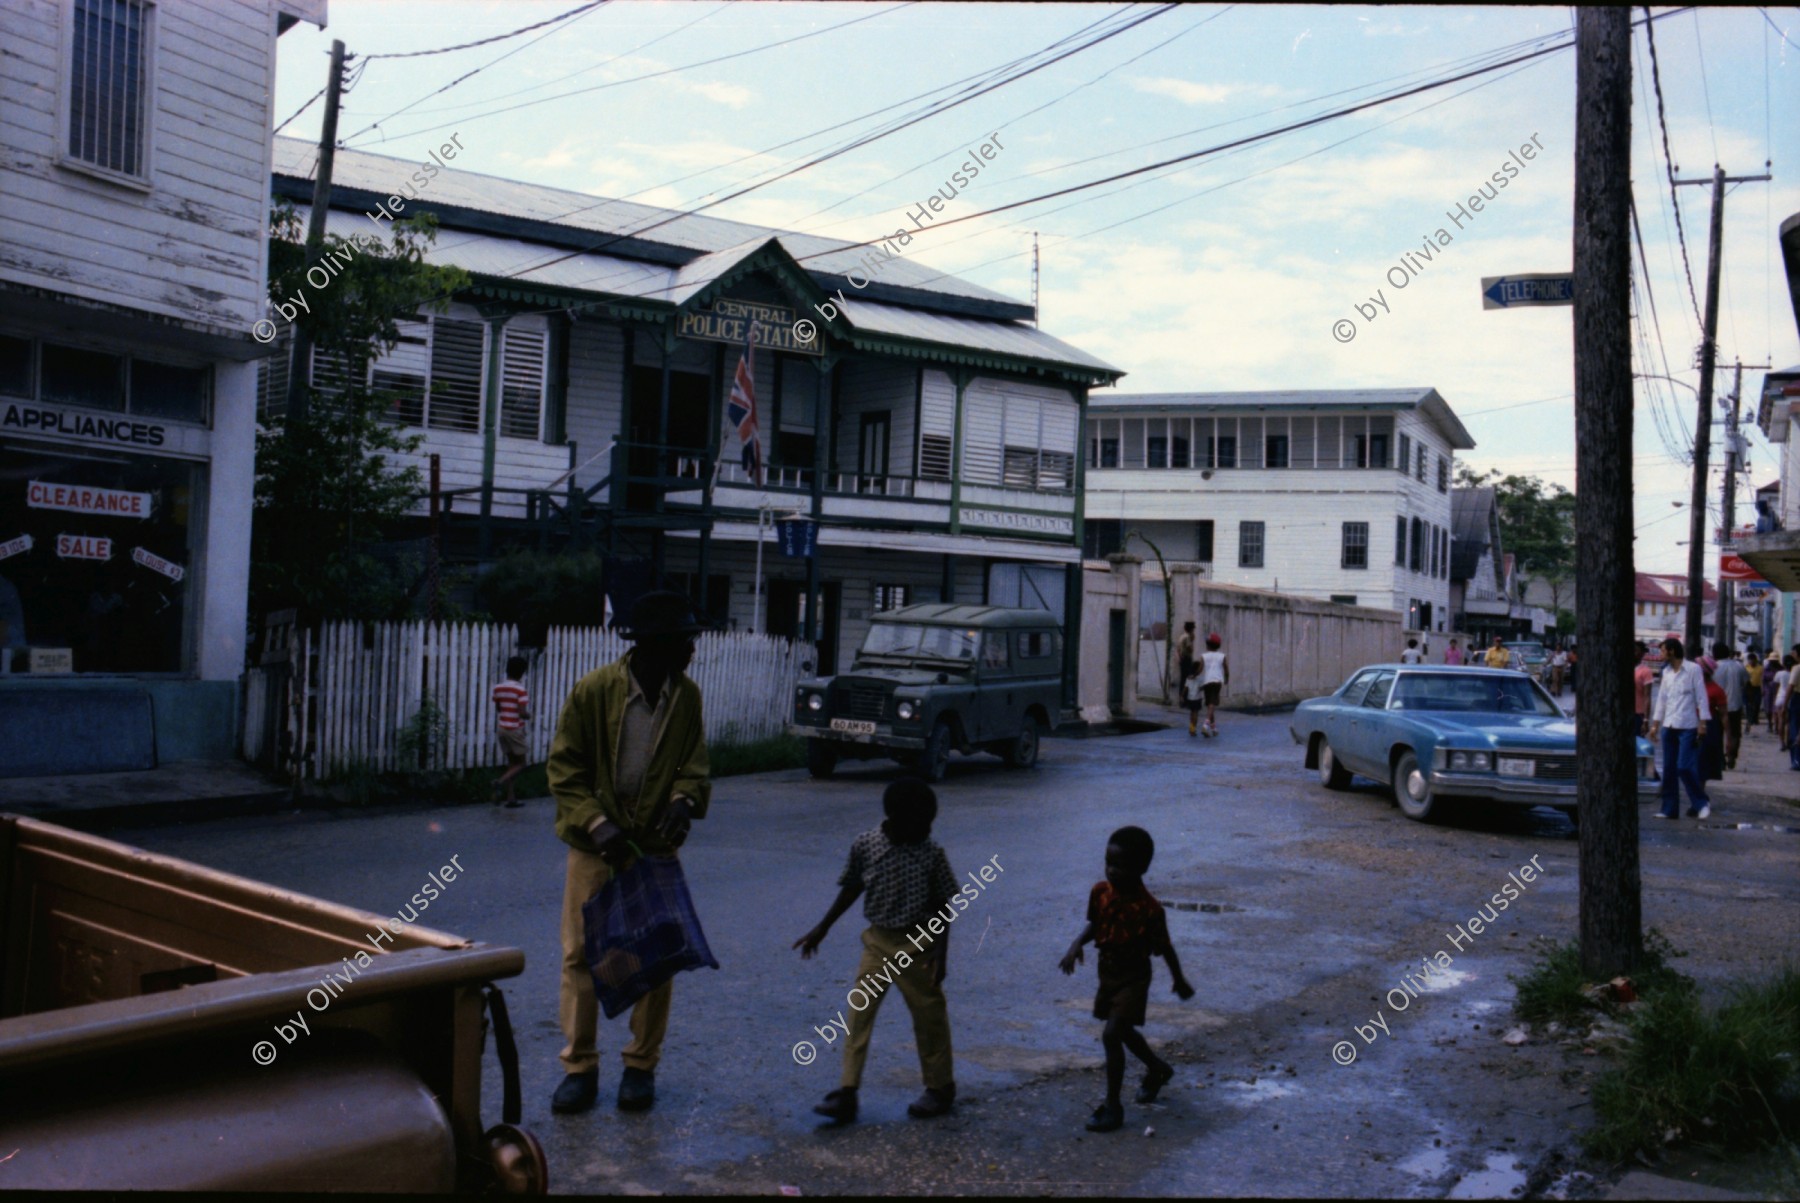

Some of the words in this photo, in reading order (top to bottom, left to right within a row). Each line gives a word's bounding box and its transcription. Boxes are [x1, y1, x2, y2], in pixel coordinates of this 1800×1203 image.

[1499, 279, 1566, 302] TELEPHONE
[715, 300, 791, 325] CENTRAL
[681, 312, 744, 341] POLICE
[749, 319, 819, 351] STATION
[3, 404, 165, 446] APPLIANCES
[30, 484, 142, 513] CLEARANCE
[60, 537, 108, 557] SALE
[135, 549, 167, 573] BLOUSE
[834, 720, 846, 730] 60
[847, 721, 859, 731] AM
[860, 722, 872, 732] 95
